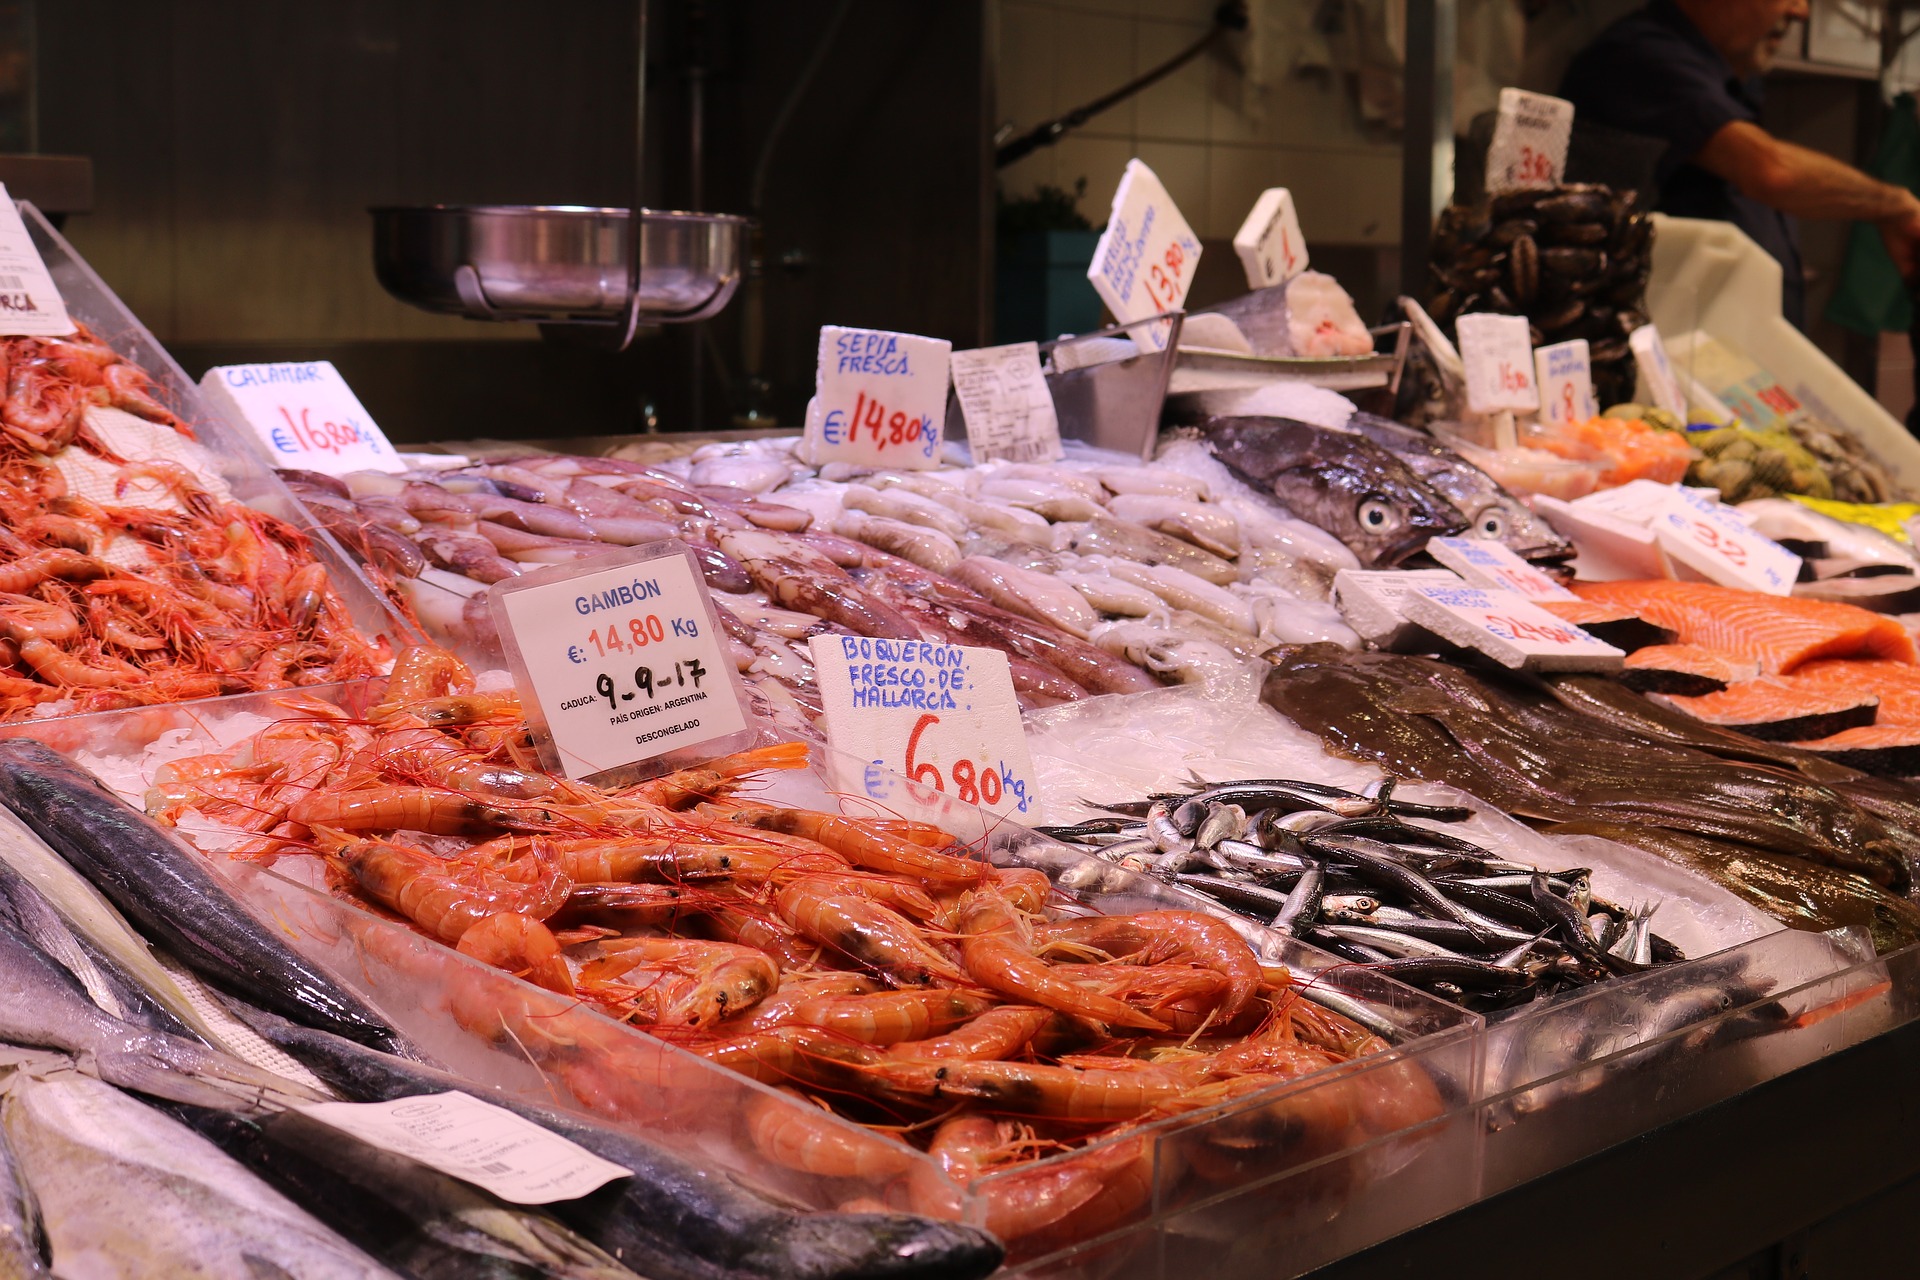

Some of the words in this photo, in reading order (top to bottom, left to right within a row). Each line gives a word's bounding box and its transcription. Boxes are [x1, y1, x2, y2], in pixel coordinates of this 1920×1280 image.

[226, 365, 324, 388] CALAMAR
[278, 404, 360, 456] 16,80
[848, 389, 922, 451] 14,80
[1692, 521, 1748, 568] 32
[575, 578, 662, 615] GAMBÓN
[567, 645, 588, 665] €:
[588, 613, 665, 658] 14,80
[671, 617, 699, 639] Kg
[560, 693, 598, 711] CADUCA:
[609, 712, 630, 726] PAÍS
[629, 704, 663, 721] ORIGEN:
[664, 690, 708, 711] ARGENTINA
[635, 718, 700, 745] DESCONGELADO
[905, 713, 1002, 814] 6,80
